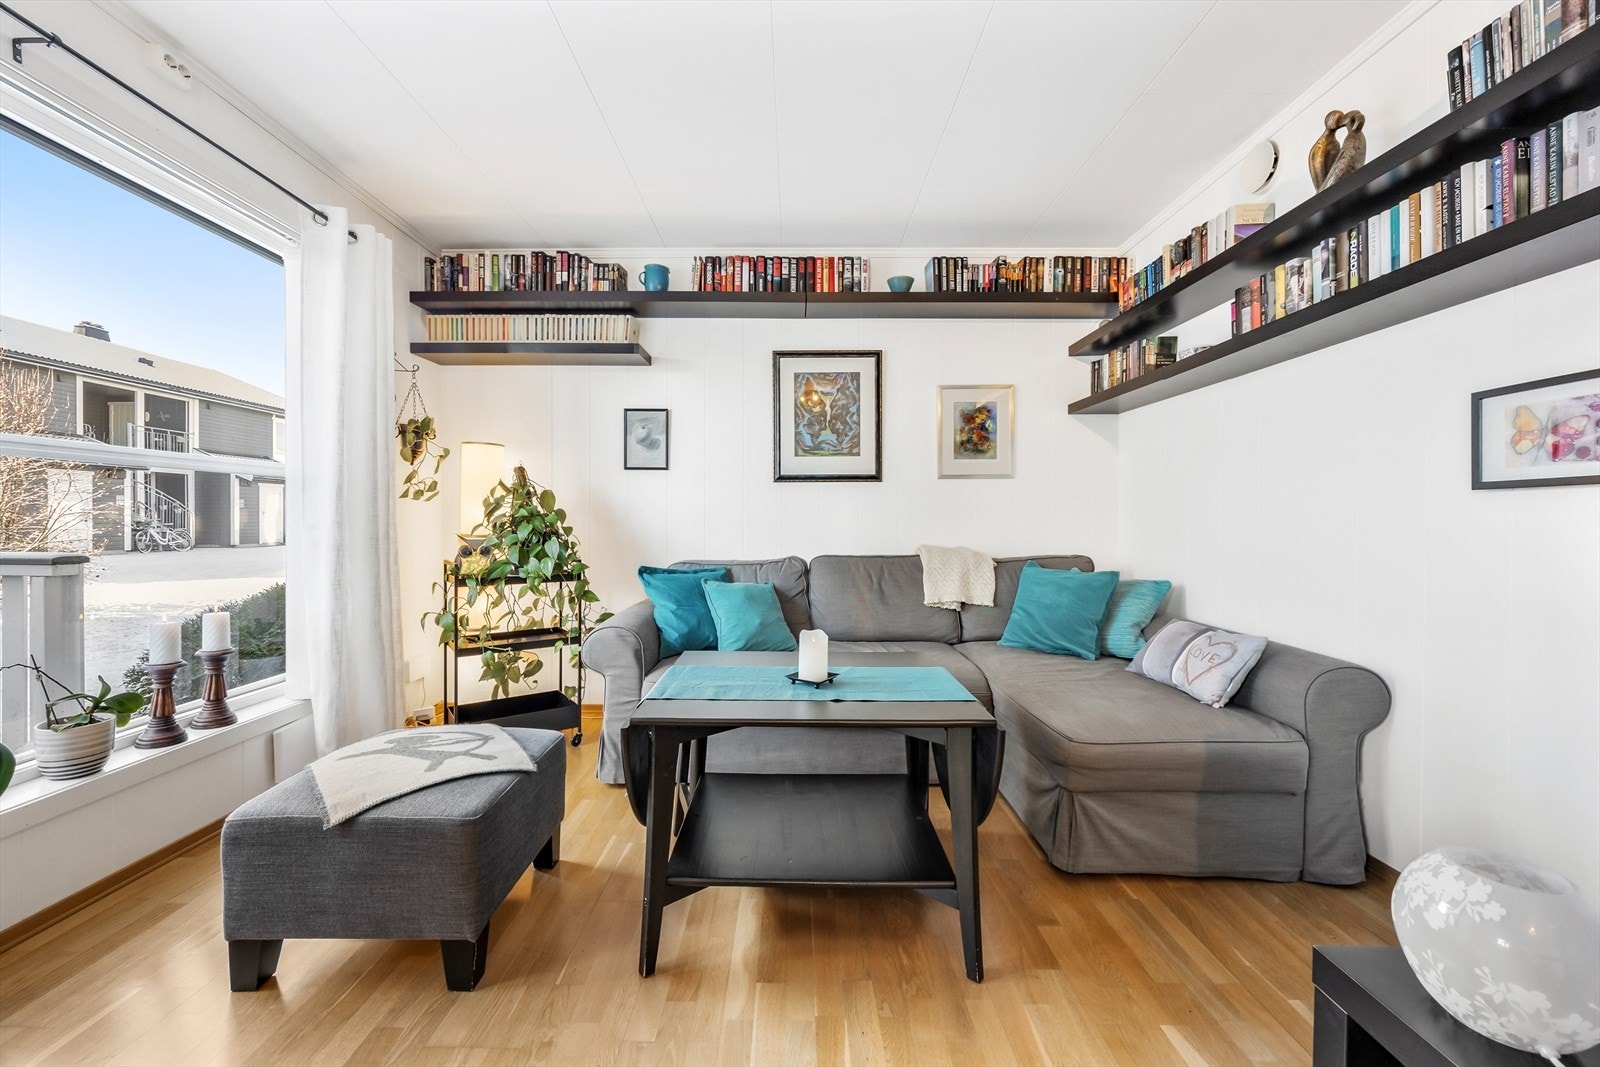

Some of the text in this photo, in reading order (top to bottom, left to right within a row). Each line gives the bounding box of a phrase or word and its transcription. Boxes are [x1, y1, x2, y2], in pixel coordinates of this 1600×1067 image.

[1549, 126, 1557, 146] ANNE
[1501, 145, 1509, 164] ANNE
[1549, 147, 1557, 170] KARIN
[1533, 136, 1541, 207] ANNE KARIN ELSTAD
[1549, 172, 1557, 198] ELSTAD
[1350, 240, 1358, 277] RAGDE
[1189, 647, 1221, 664] LOVE
